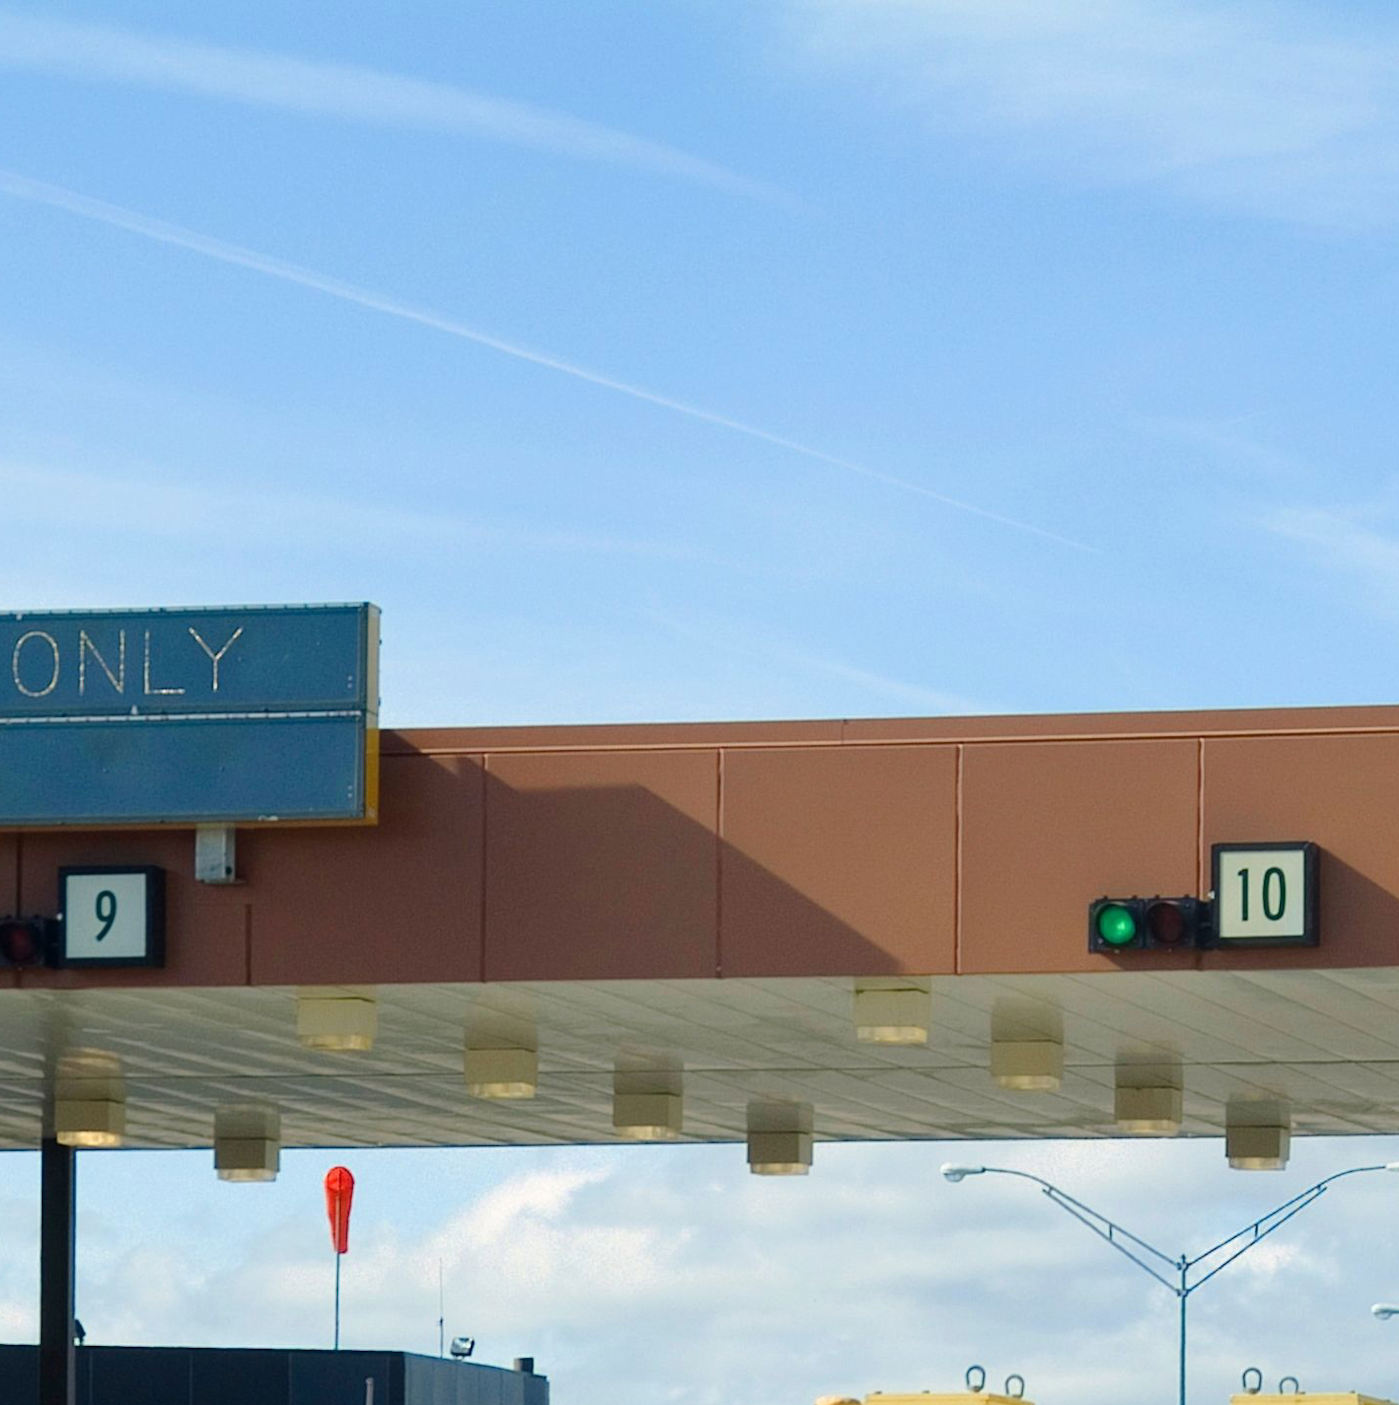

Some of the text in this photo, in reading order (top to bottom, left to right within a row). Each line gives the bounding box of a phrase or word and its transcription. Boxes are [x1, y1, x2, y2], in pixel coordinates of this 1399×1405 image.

[11, 626, 244, 698] ONLY
[93, 889, 118, 942] 9
[1237, 867, 1286, 921] 10
